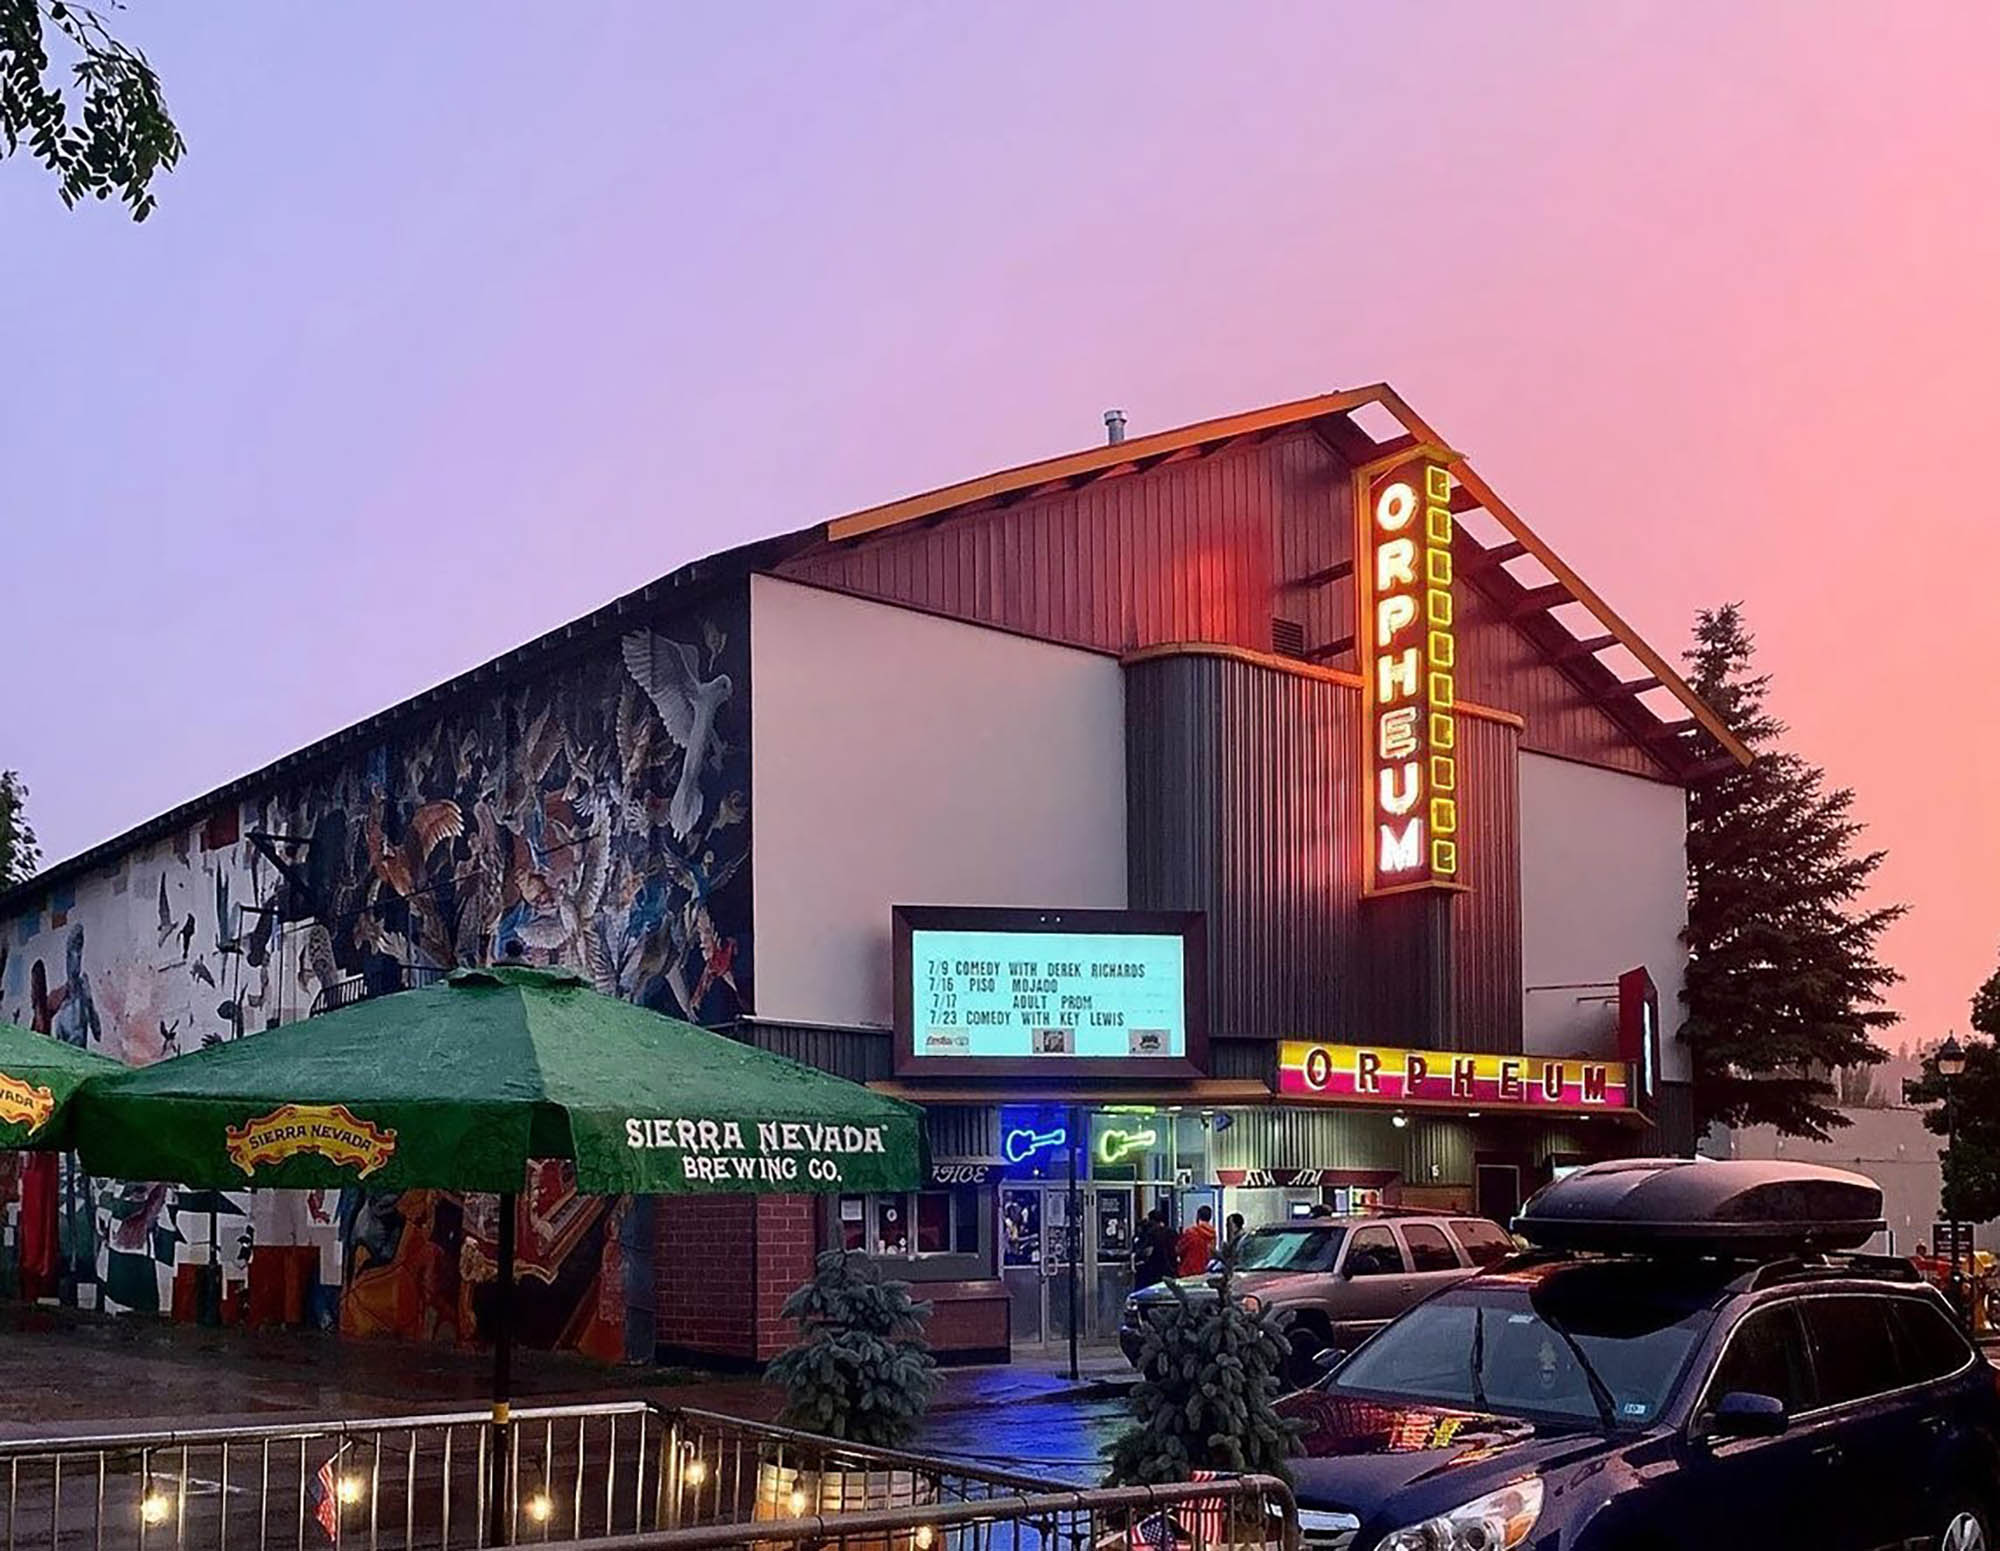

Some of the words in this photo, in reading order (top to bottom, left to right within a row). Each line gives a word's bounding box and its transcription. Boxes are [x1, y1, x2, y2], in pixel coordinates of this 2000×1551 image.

[1375, 481, 1424, 872] ORPHEUM
[928, 960, 949, 975] 7/9
[955, 961, 1000, 976] COMEDY
[1008, 962, 1038, 976] WITH
[1047, 962, 1082, 977] DEREK
[1090, 963, 1146, 978] RICHARDS
[969, 978, 996, 992] PISO
[933, 993, 957, 1008] 7/17
[1013, 994, 1048, 1009] ADULT
[1061, 995, 1093, 1010] PROM
[929, 1010, 958, 1025] 7/23
[966, 1011, 1011, 1025] COMEDY
[1021, 1011, 1050, 1025] WITH
[1060, 1011, 1080, 1026] KEY
[1090, 1012, 1125, 1026] LEWIS
[1303, 1046, 1608, 1104] ORPHEUM
[248, 1125, 308, 1150] SIERRA
[310, 1125, 372, 1152] NEVADA
[625, 1117, 745, 1155] SIERRA
[757, 1122, 886, 1156] NEVADA
[682, 1155, 798, 1183] BREWING
[807, 1157, 843, 1182] CO.
[1245, 1168, 1277, 1186] ATM
